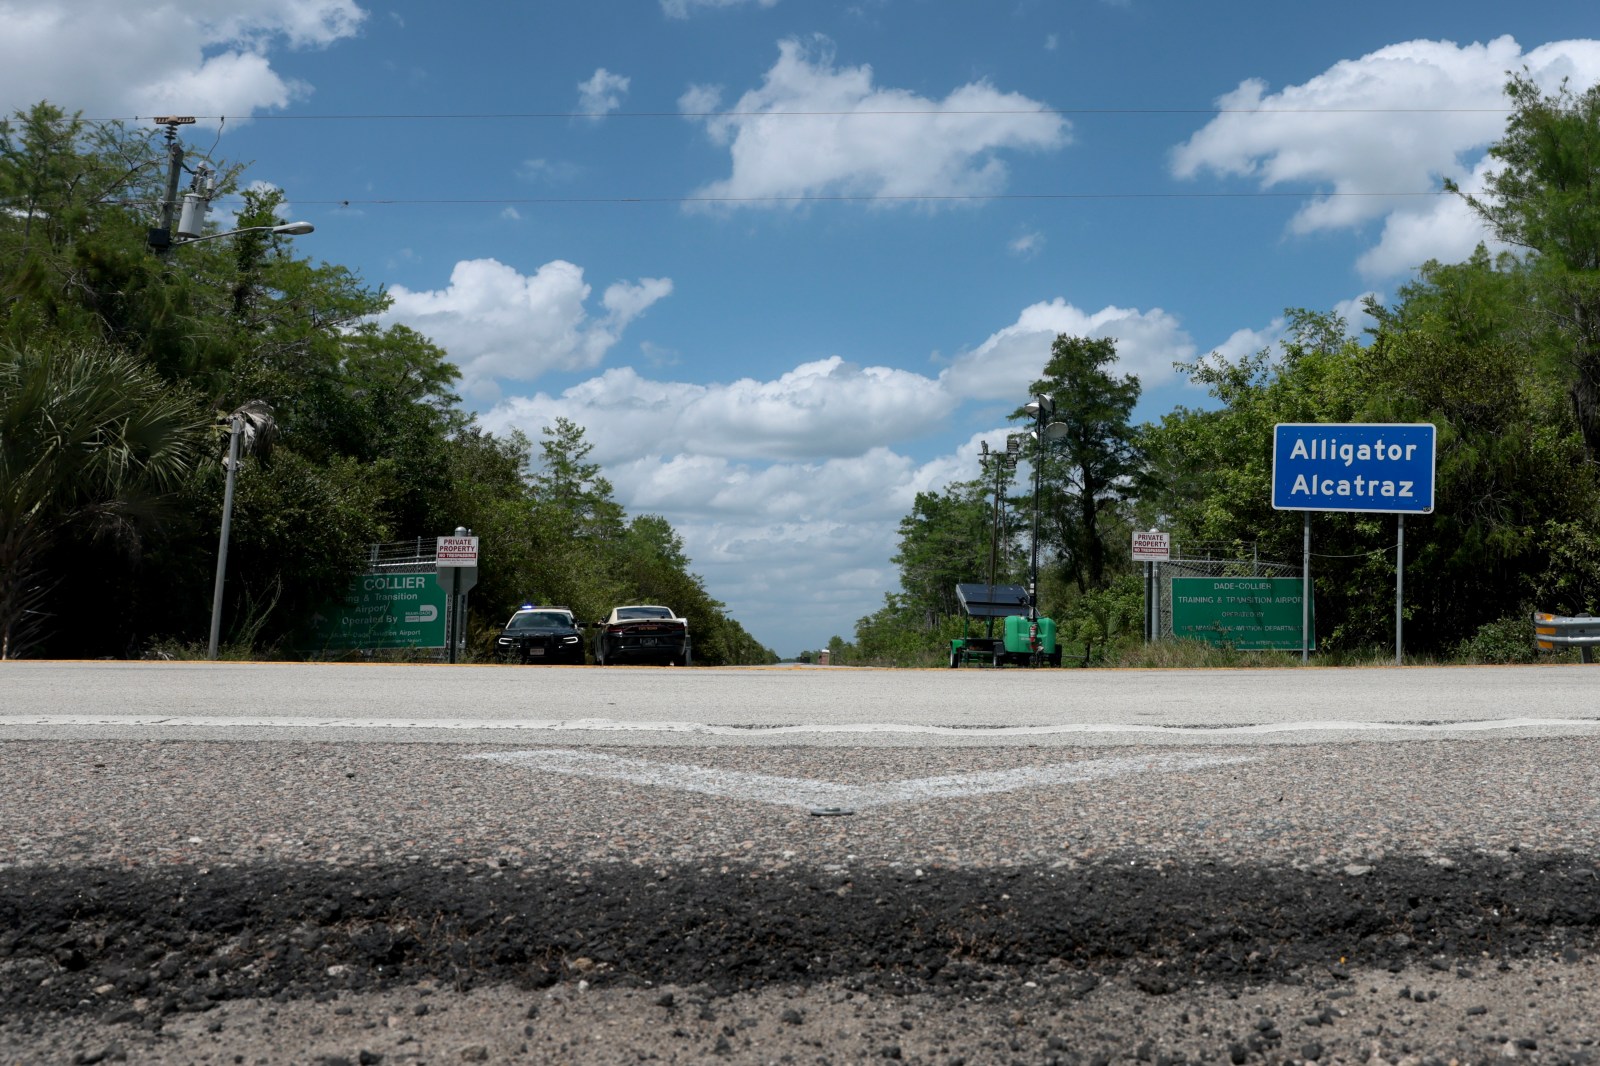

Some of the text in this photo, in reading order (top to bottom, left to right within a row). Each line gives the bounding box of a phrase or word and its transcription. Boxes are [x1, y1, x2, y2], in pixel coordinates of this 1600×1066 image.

[1290, 438, 1417, 467] Alligator
[1291, 474, 1414, 497] Alcatraz
[363, 577, 425, 591] COLLIER
[1213, 582, 1272, 590] DADE-COLLIER
[363, 594, 370, 602] &
[375, 592, 418, 601] Transition
[1178, 596, 1304, 604] TRAINING & TRANSITION AIRPOR
[355, 604, 387, 615] Airport
[386, 614, 398, 624] By
